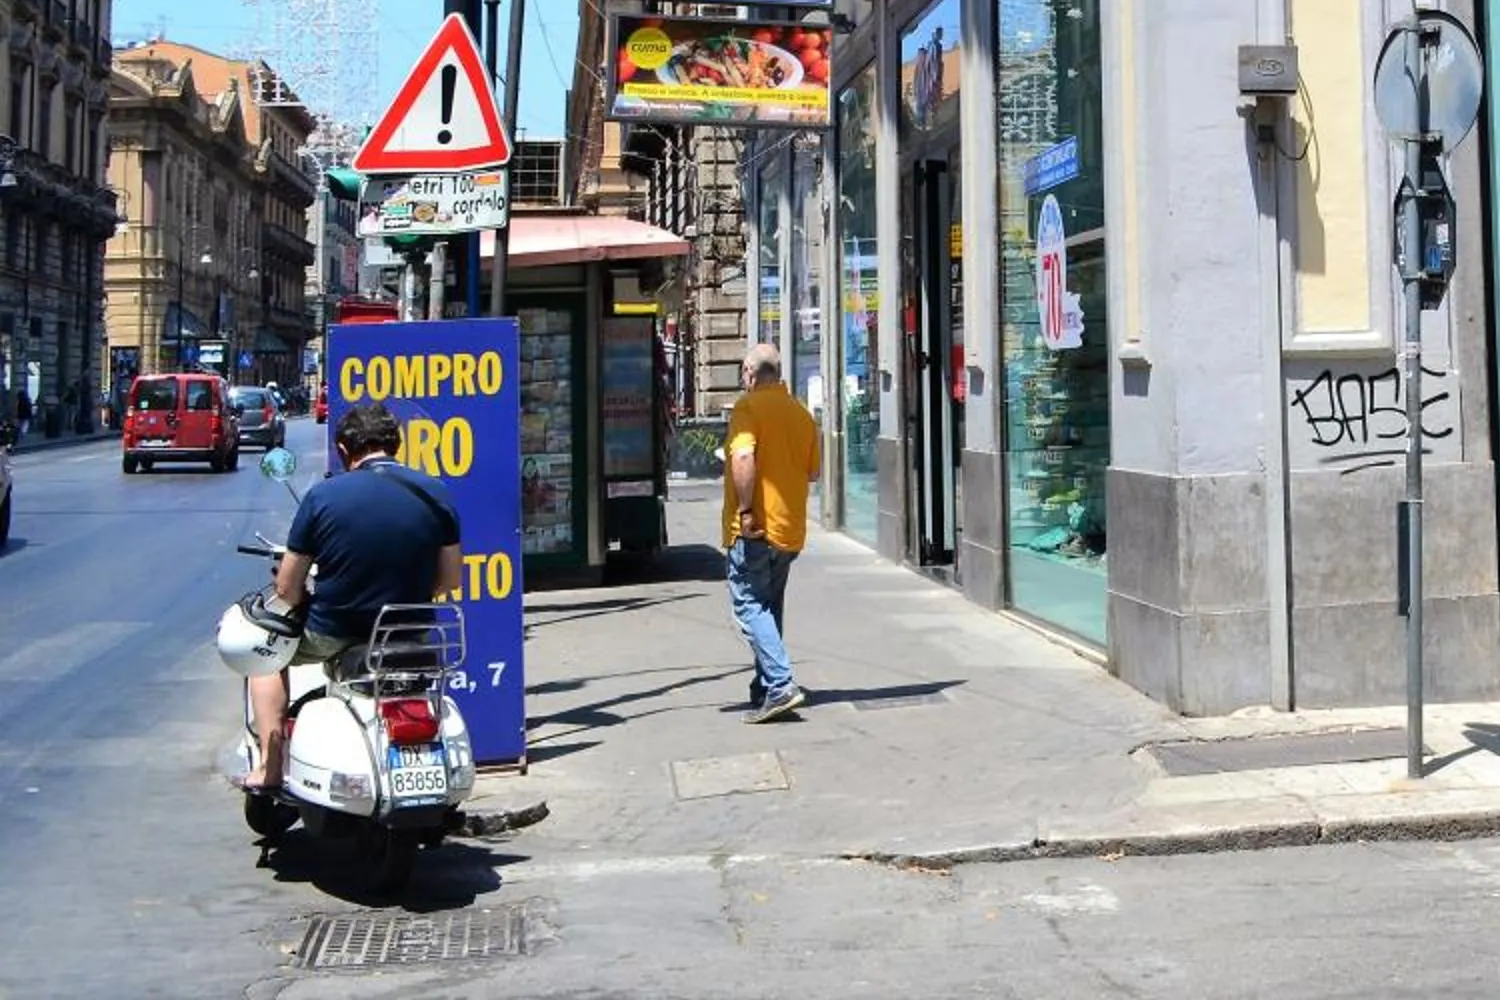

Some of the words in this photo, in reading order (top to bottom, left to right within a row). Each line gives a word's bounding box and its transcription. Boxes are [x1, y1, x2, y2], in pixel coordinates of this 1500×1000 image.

[410, 176, 443, 195] etri
[340, 351, 503, 402] COMPRO
[395, 416, 474, 477] RO
[487, 661, 506, 687] 7
